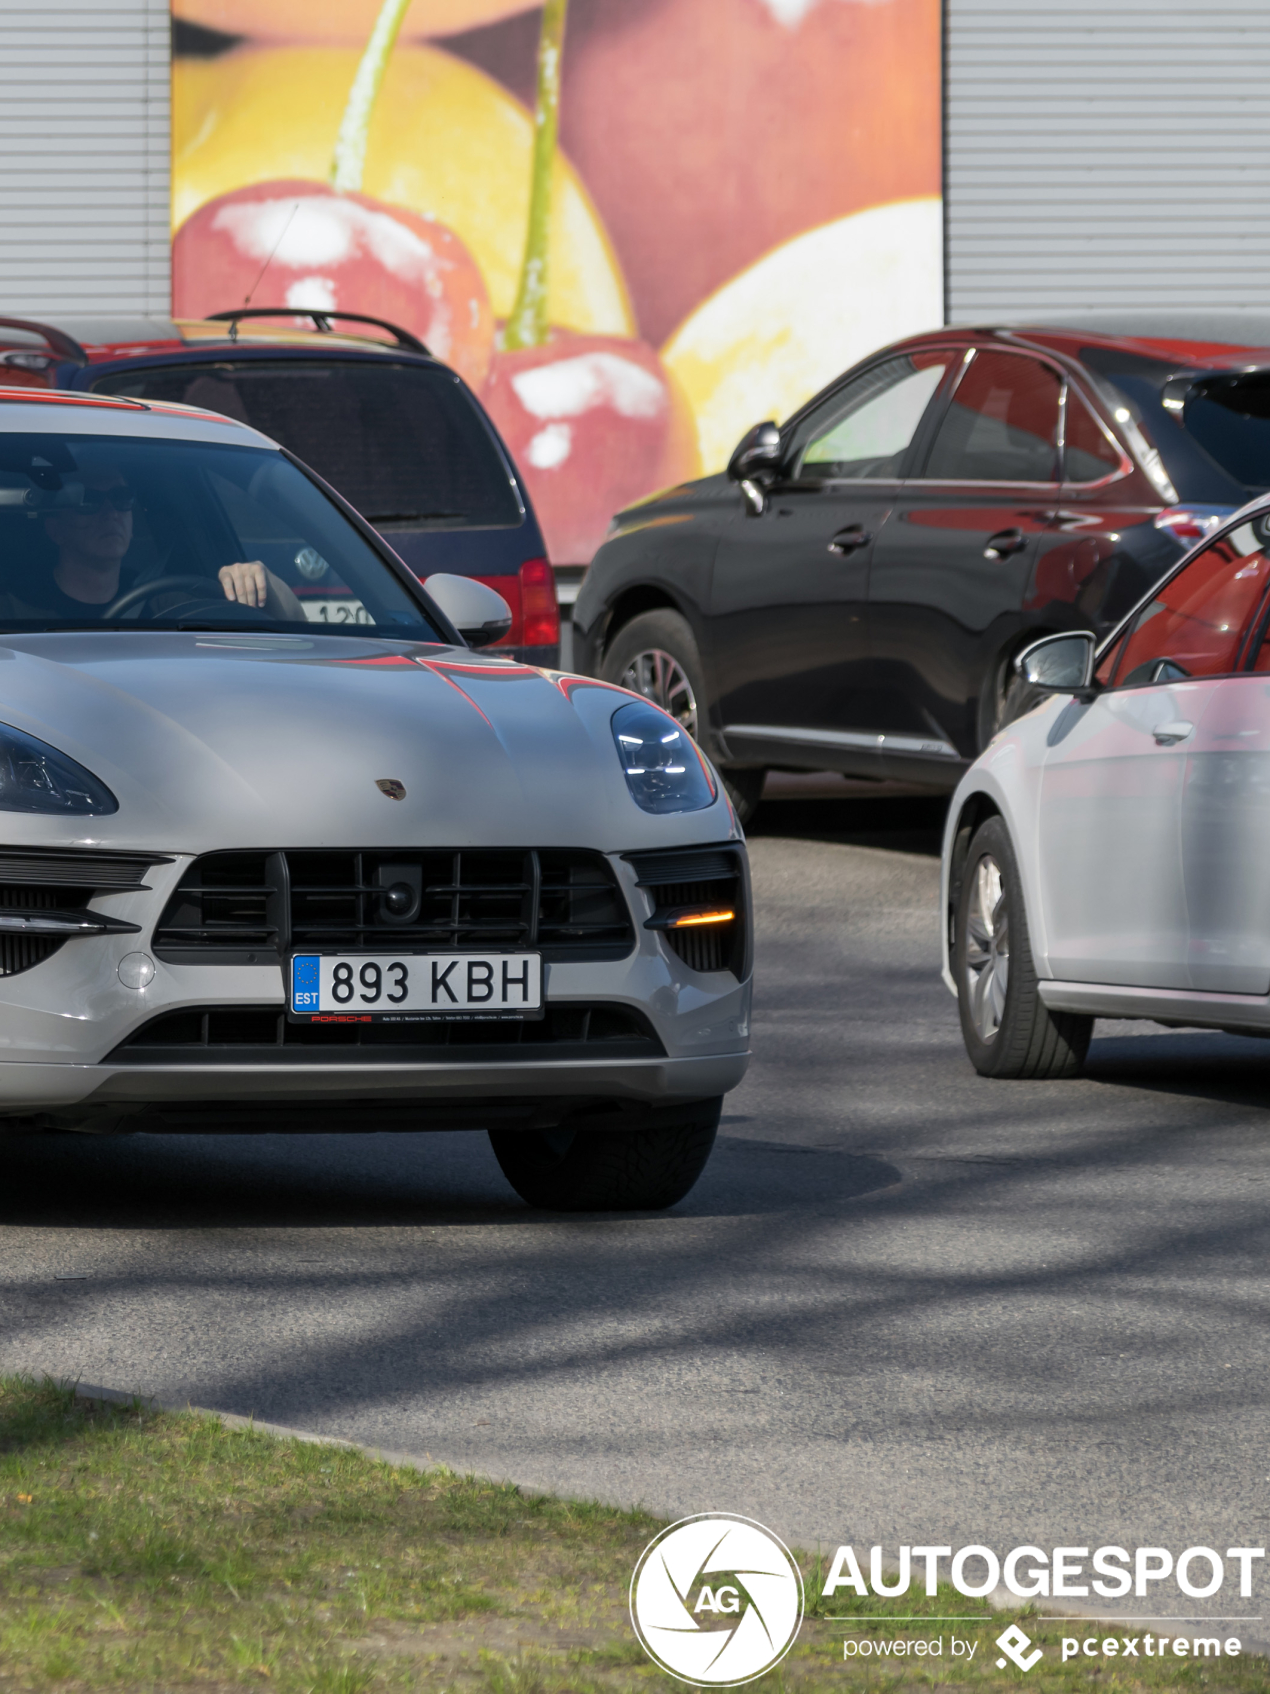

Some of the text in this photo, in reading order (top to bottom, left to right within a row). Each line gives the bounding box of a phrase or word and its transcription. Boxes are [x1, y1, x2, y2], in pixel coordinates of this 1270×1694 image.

[331, 960, 529, 1004] 893 KBH
[295, 992, 319, 1005] EST
